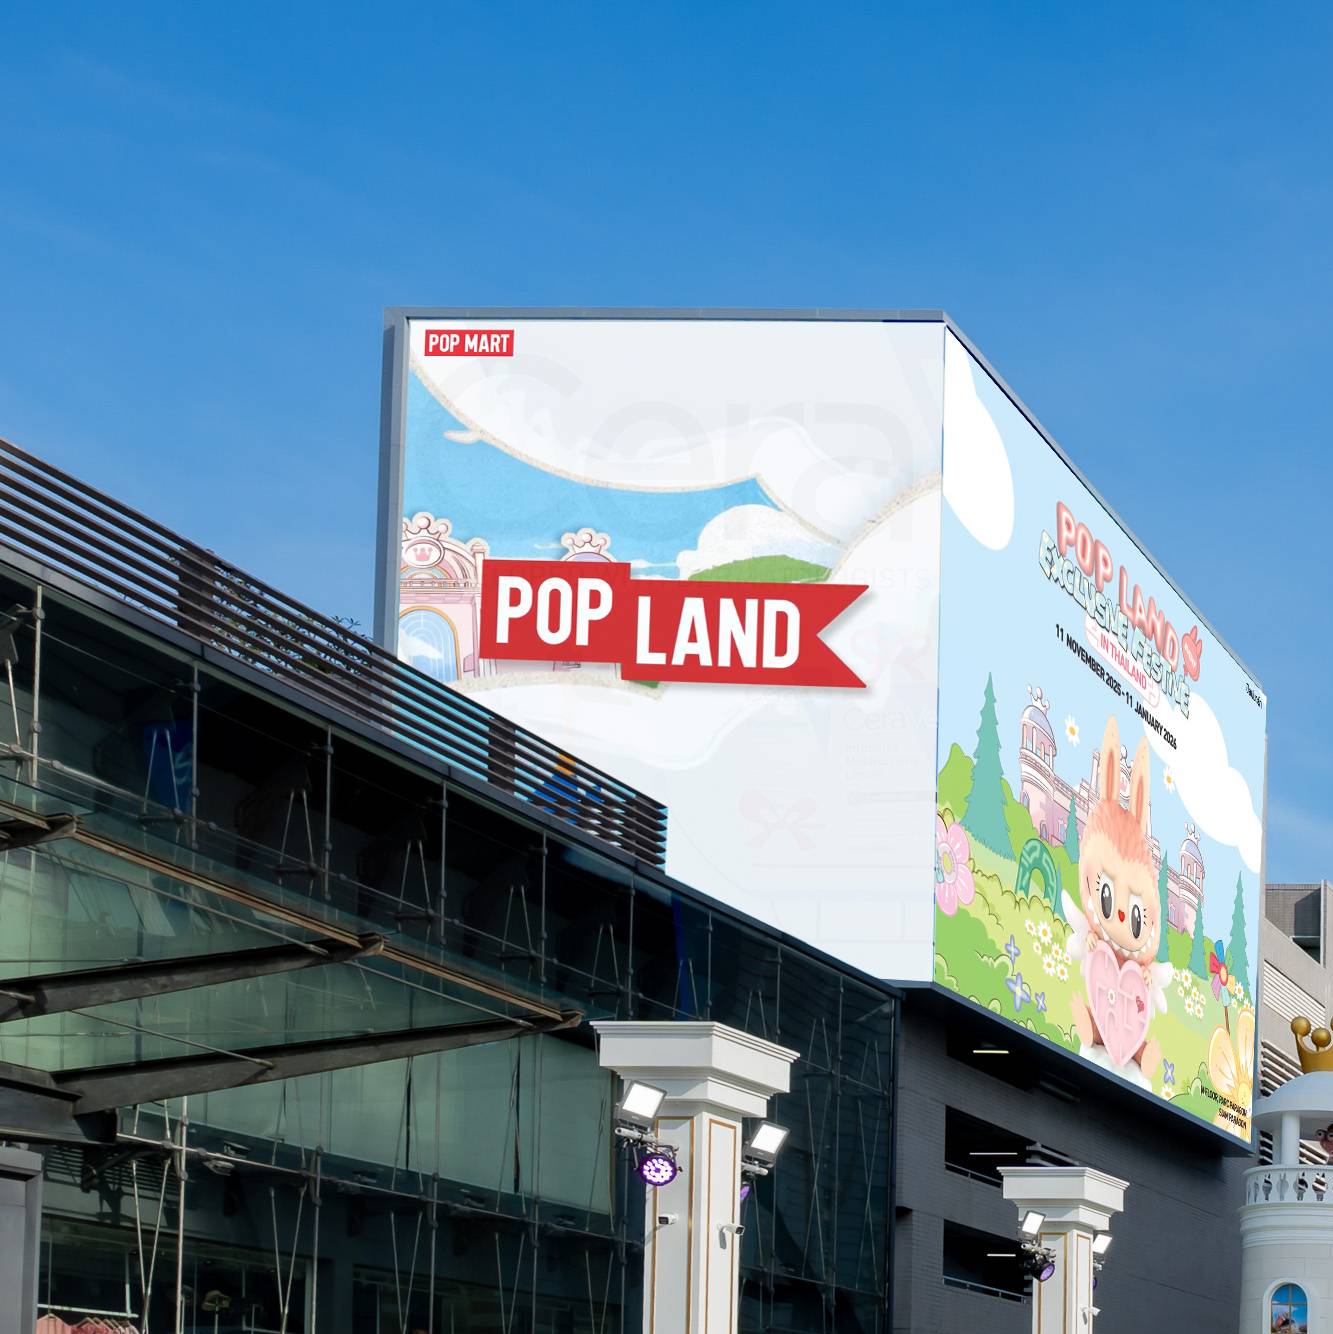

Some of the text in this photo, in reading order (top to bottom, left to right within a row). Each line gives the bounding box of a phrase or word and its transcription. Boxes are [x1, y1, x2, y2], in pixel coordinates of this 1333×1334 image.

[428, 333, 510, 353] POP MART
[496, 575, 801, 669] POP LAND
[1039, 529, 1190, 720] EXCLUSIVE FESTIVE
[1056, 501, 1180, 672] POP LAND
[1056, 623, 1064, 642] 11
[1066, 633, 1105, 681] NOVEMBER
[1105, 671, 1121, 697] 2025
[1126, 691, 1133, 708] 11
[1134, 701, 1164, 736] JANUARY
[1163, 728, 1177, 750] 2026
[1100, 633, 1109, 653] IN
[1110, 642, 1147, 690] THAILAND
